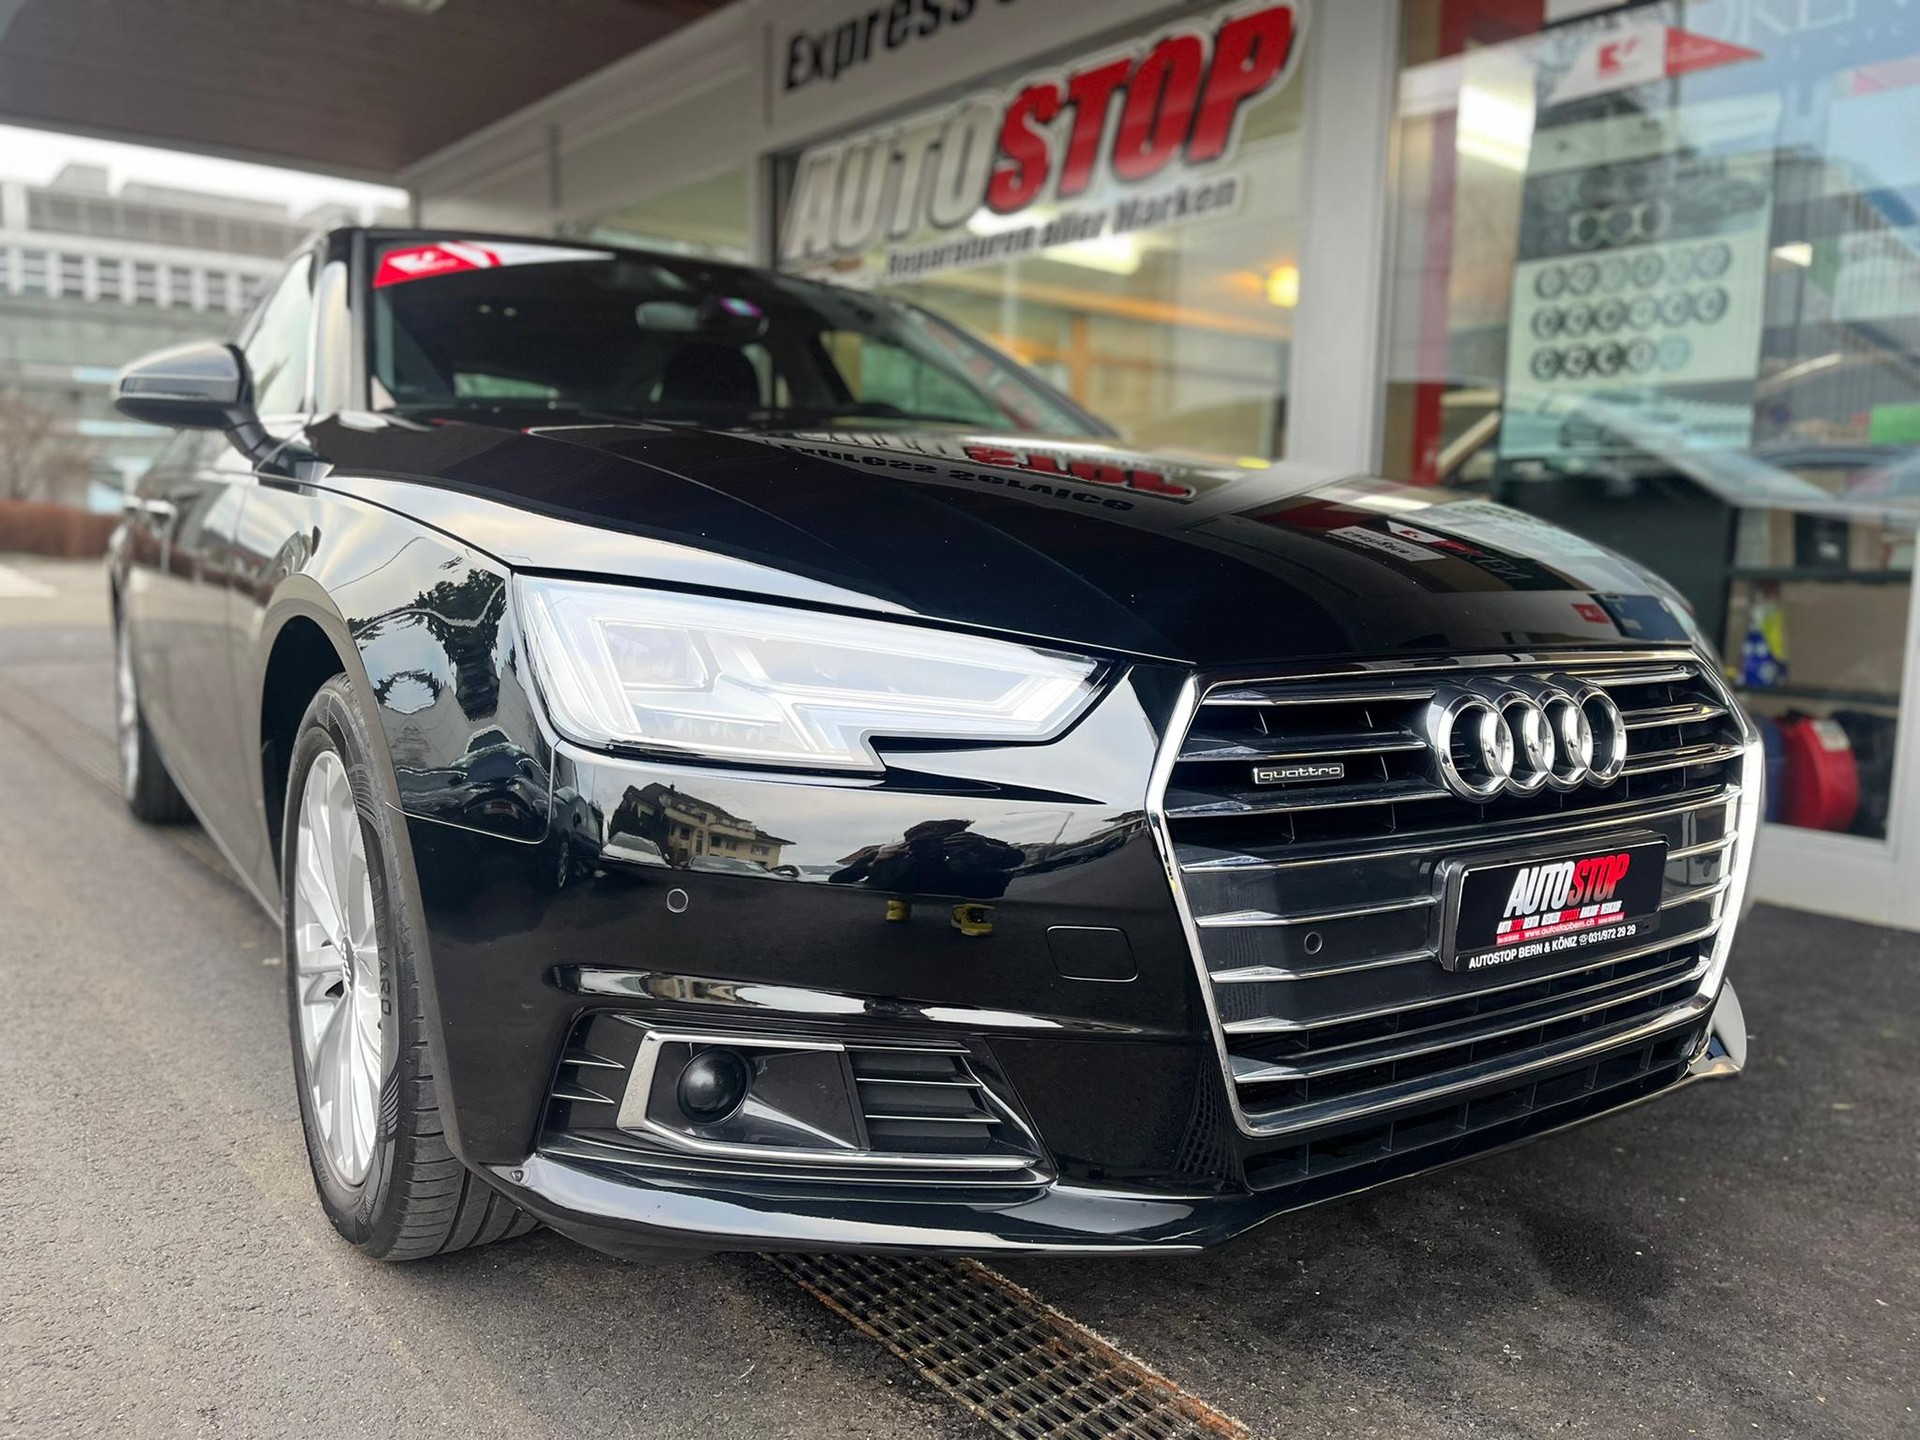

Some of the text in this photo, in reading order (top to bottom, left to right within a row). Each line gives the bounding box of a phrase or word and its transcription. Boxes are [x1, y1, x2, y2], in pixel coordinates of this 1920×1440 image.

[1260, 766, 1340, 781] quattro
[1503, 853, 1630, 918] AUTOSTOP
[1469, 924, 1636, 969] AUTOSTOP BERN & KÖNIZ 031/972 29 29
